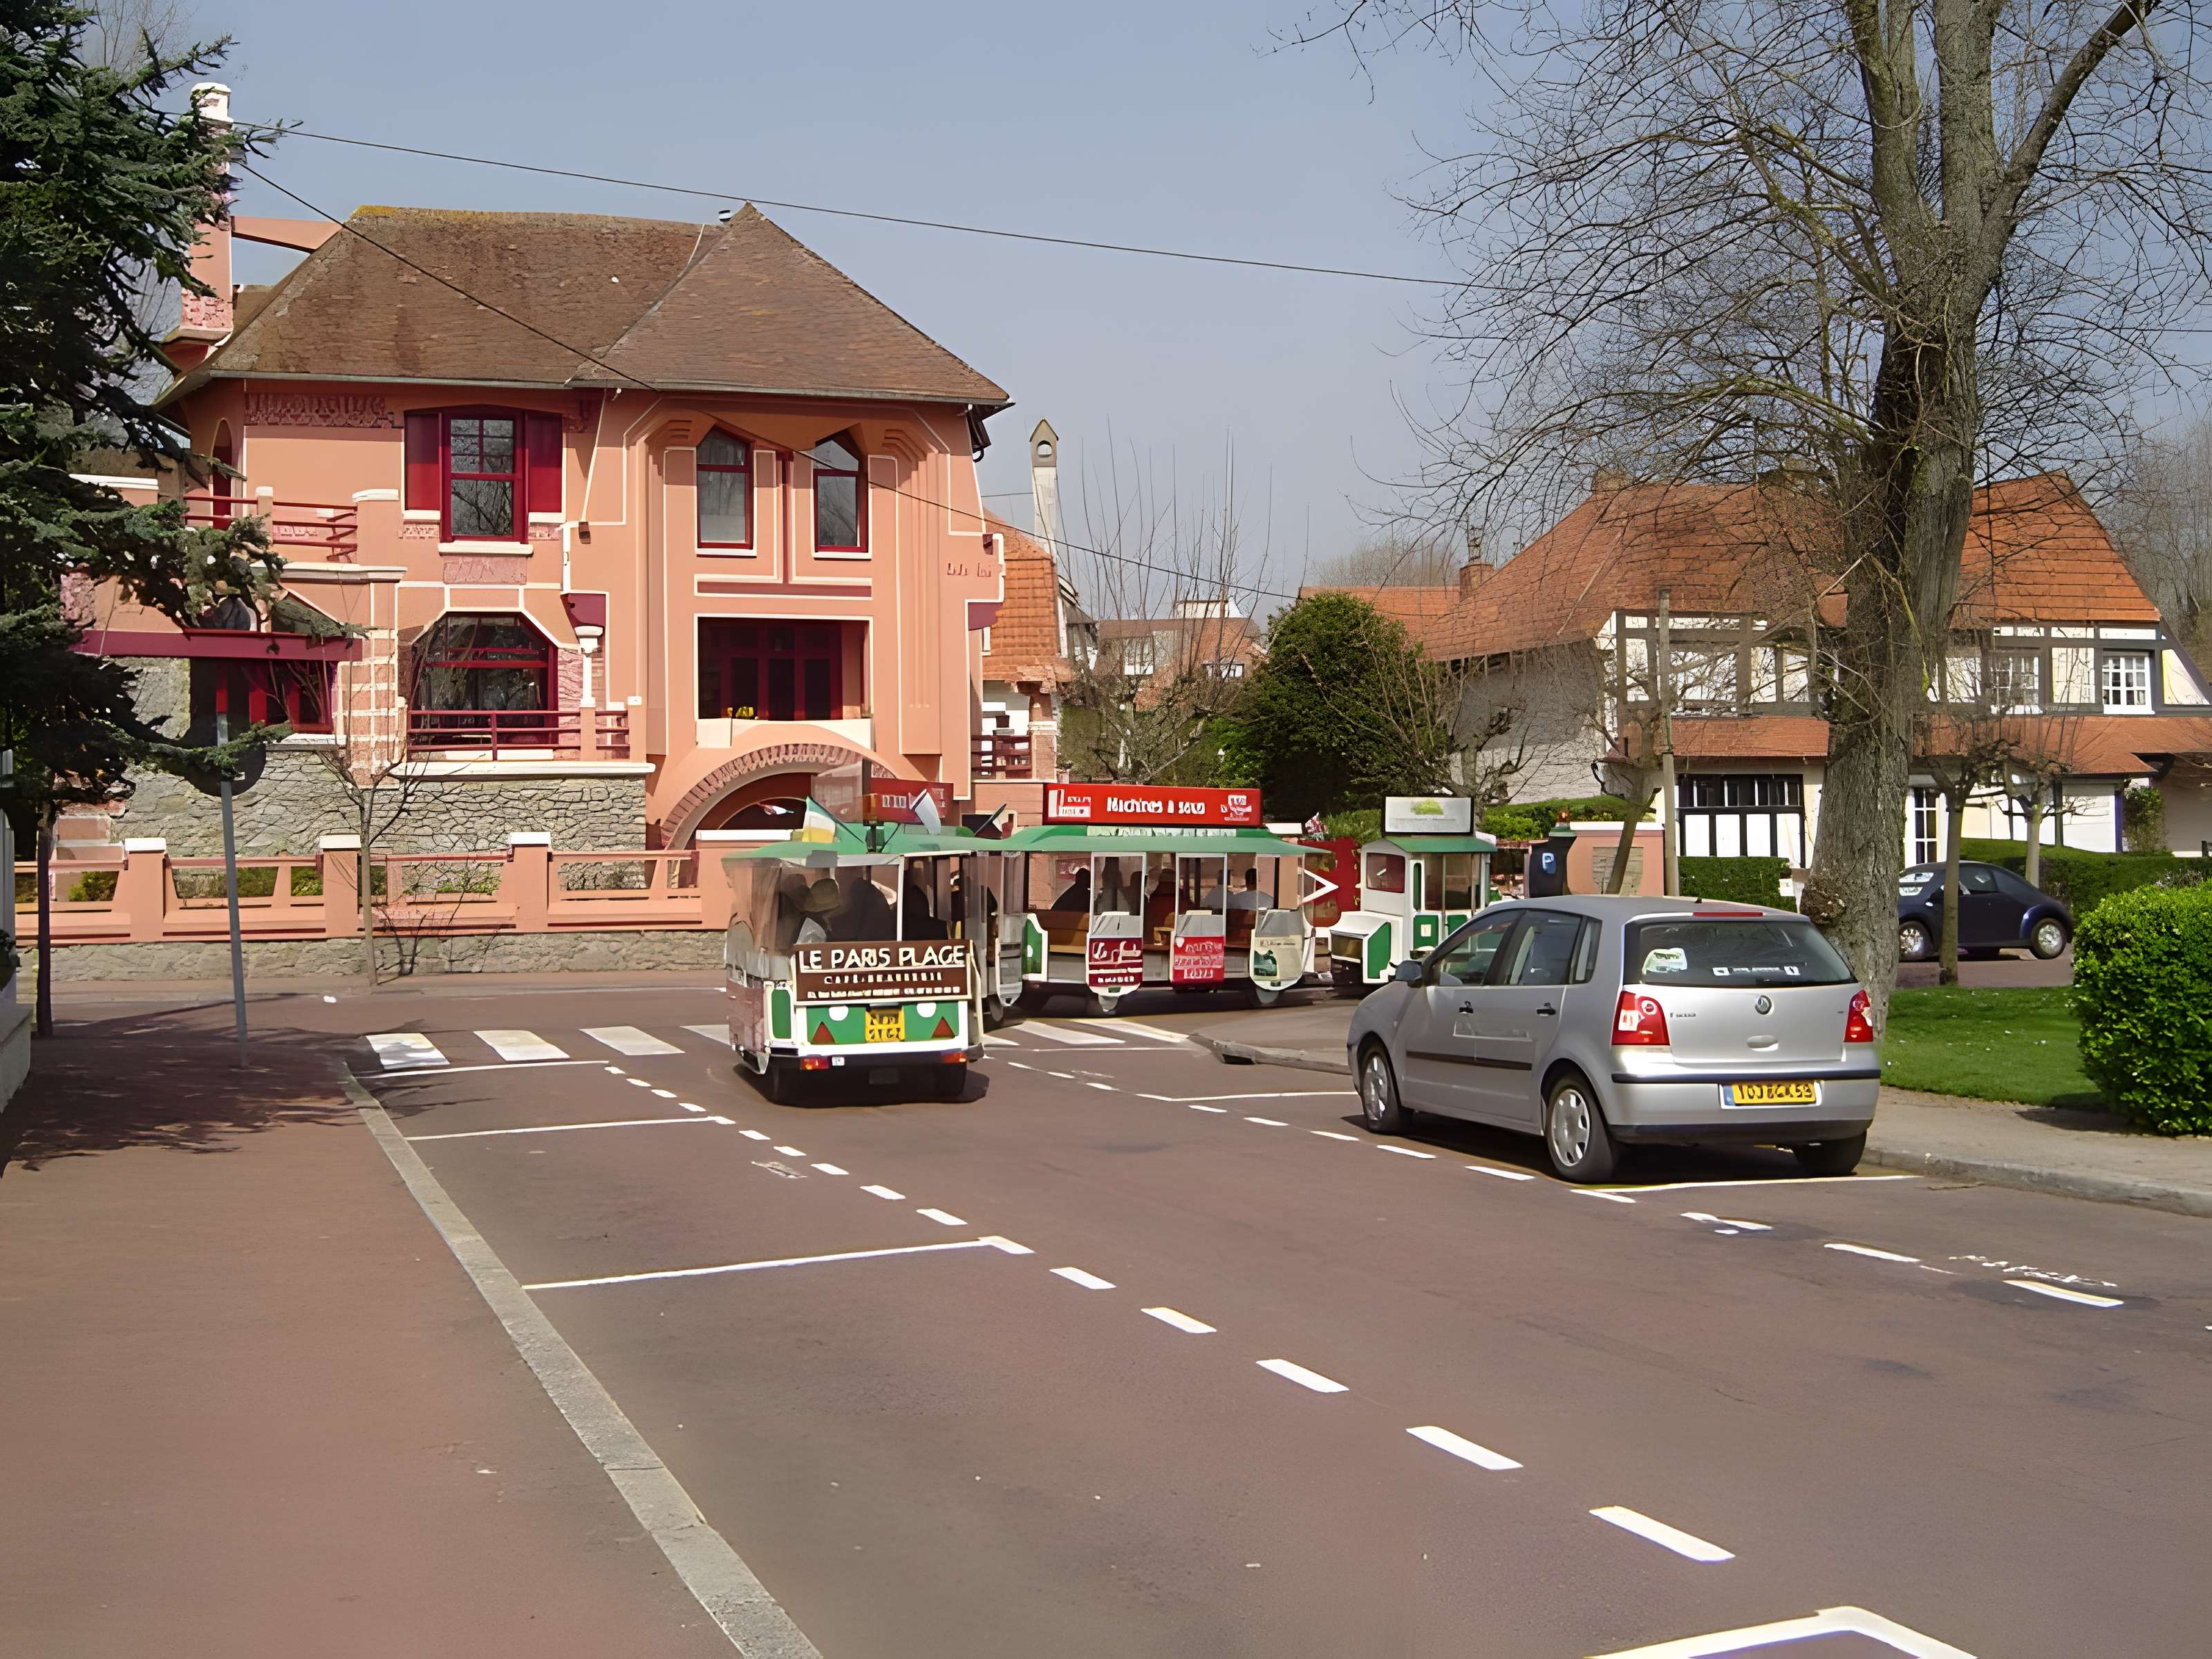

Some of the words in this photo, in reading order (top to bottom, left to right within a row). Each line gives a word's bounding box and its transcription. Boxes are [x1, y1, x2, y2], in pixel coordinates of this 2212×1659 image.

[799, 950, 822, 969] LE
[831, 948, 891, 968] PARIS
[898, 945, 966, 967] PLAGE
